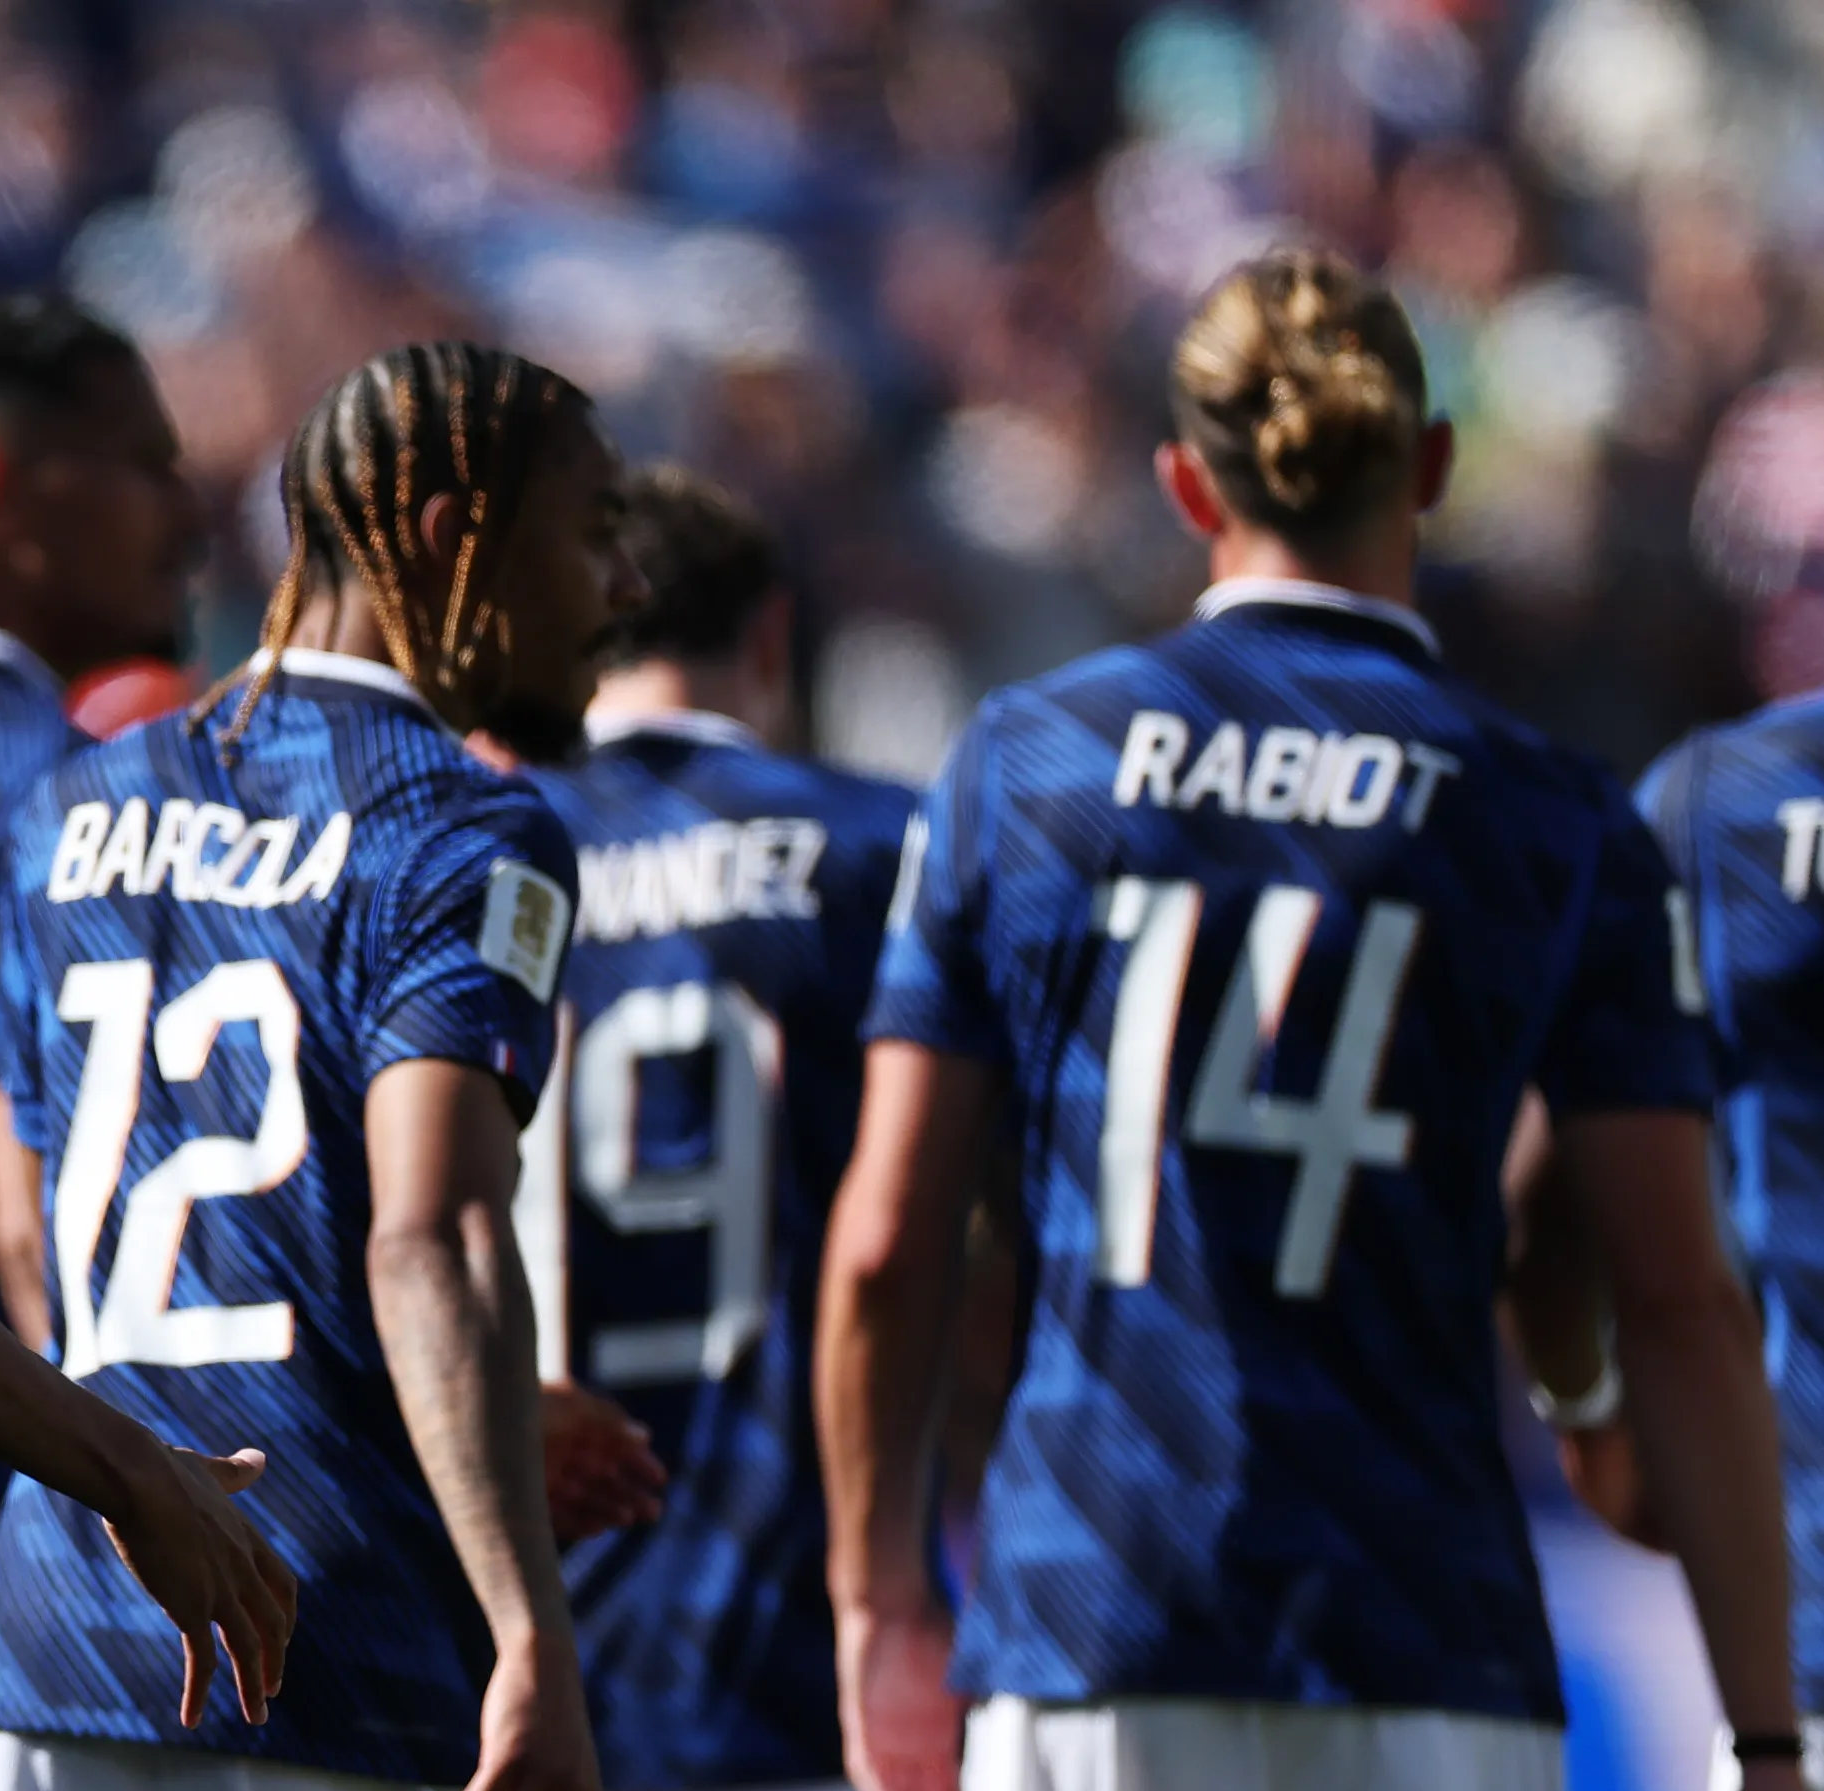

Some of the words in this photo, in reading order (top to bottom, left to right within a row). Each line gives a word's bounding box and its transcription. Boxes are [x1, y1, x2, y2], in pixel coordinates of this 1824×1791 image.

[1113, 710, 1463, 833] RABIOT
[54, 957, 308, 1379] 12
[1091, 875, 1419, 1299] 14
